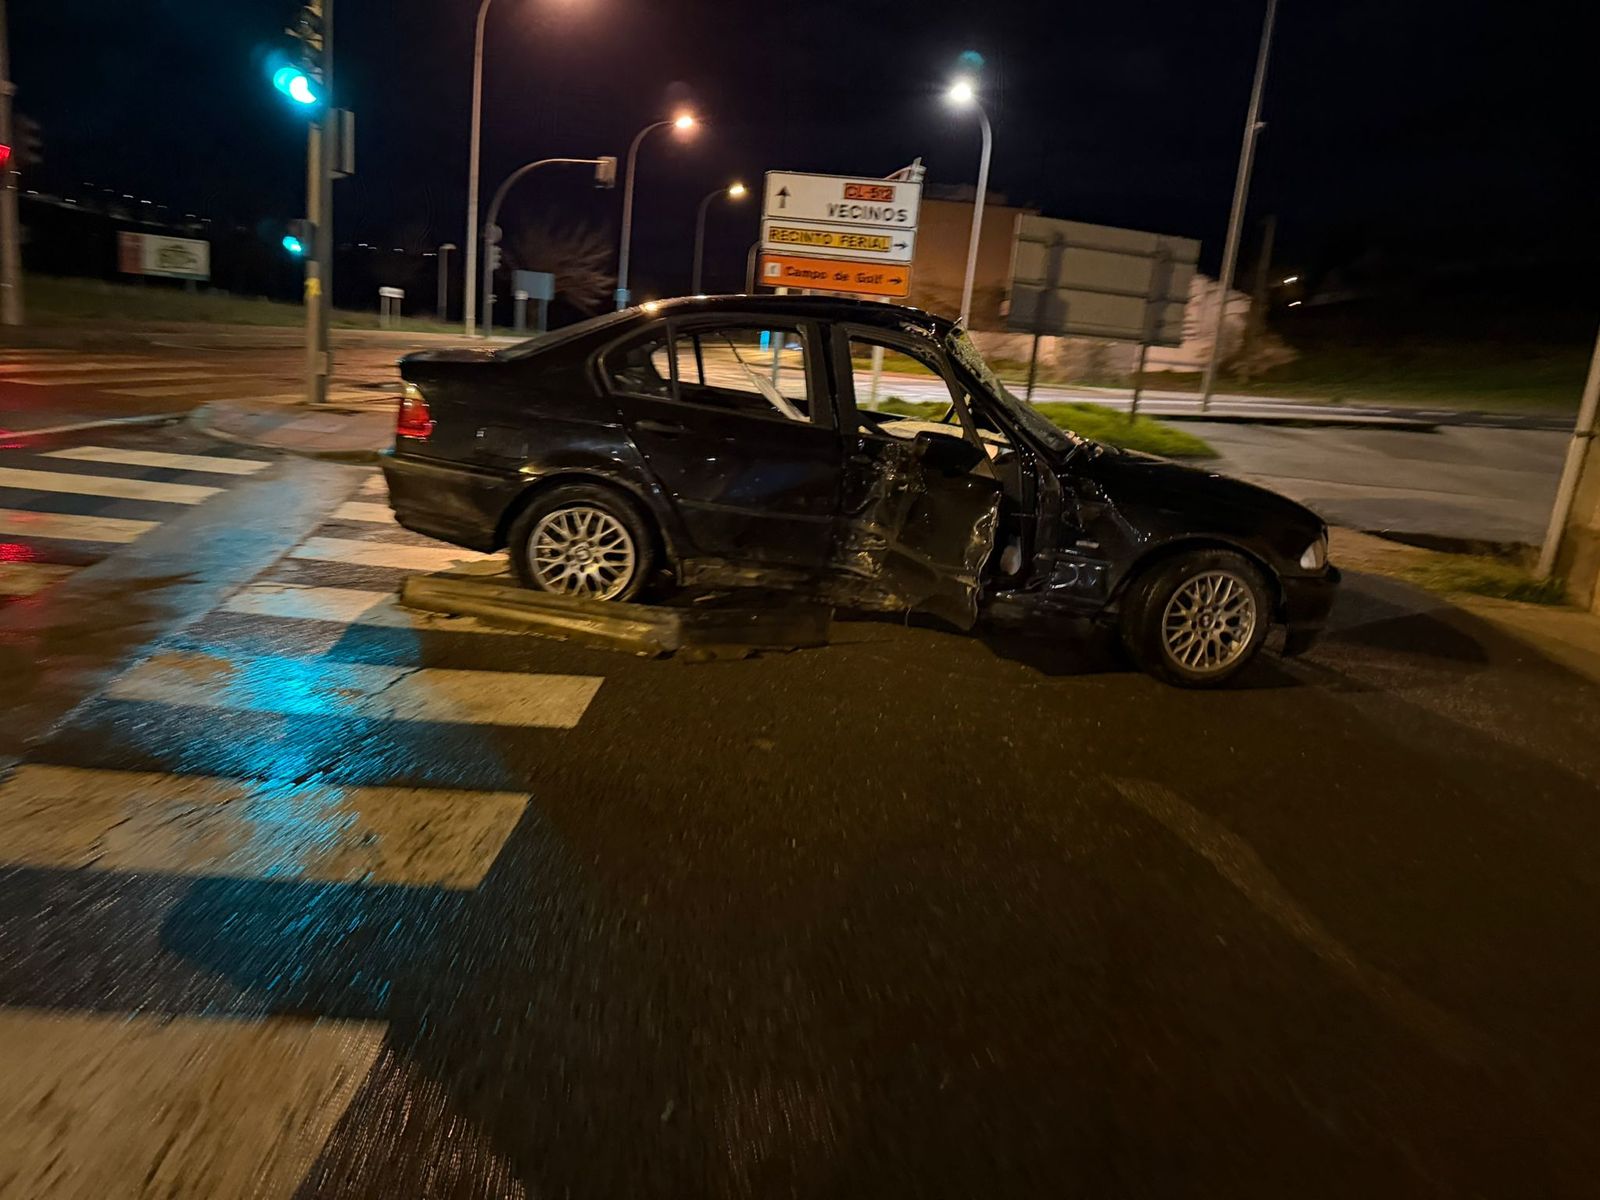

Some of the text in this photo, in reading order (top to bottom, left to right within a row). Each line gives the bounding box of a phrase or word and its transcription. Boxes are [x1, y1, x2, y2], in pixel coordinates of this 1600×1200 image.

[828, 203, 908, 222] VECINOS
[769, 229, 890, 250] RECINTO FERIAL
[785, 266, 883, 284] Campo de Golf
